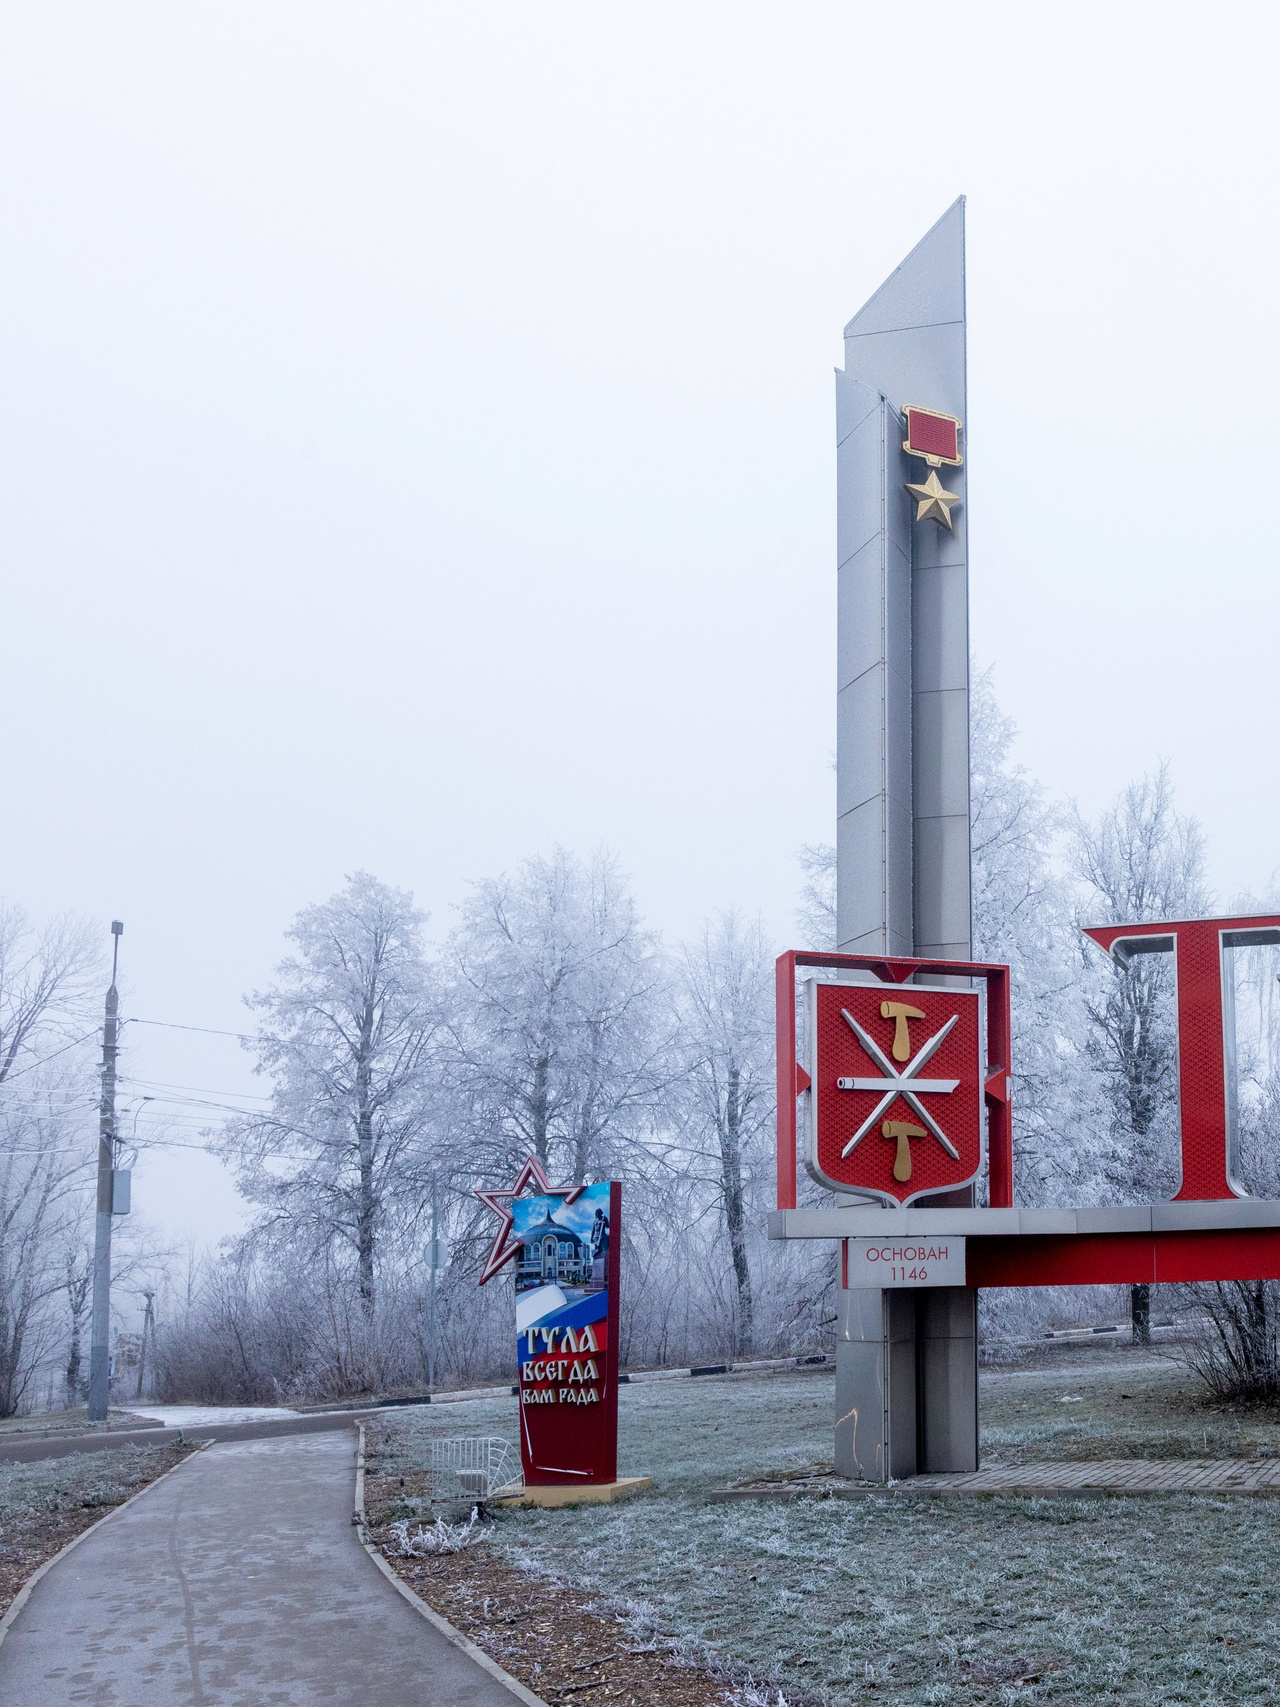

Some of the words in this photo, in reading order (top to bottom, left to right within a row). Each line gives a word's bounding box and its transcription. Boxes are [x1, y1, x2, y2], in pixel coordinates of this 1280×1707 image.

[866, 1246, 949, 1262] ОСНОВАН
[891, 1266, 928, 1281] 1146
[522, 1325, 599, 1354] ТУЛА
[522, 1359, 599, 1384] ВСЕГДА
[522, 1389, 556, 1404] ВАМ
[559, 1388, 599, 1406] РАДА
